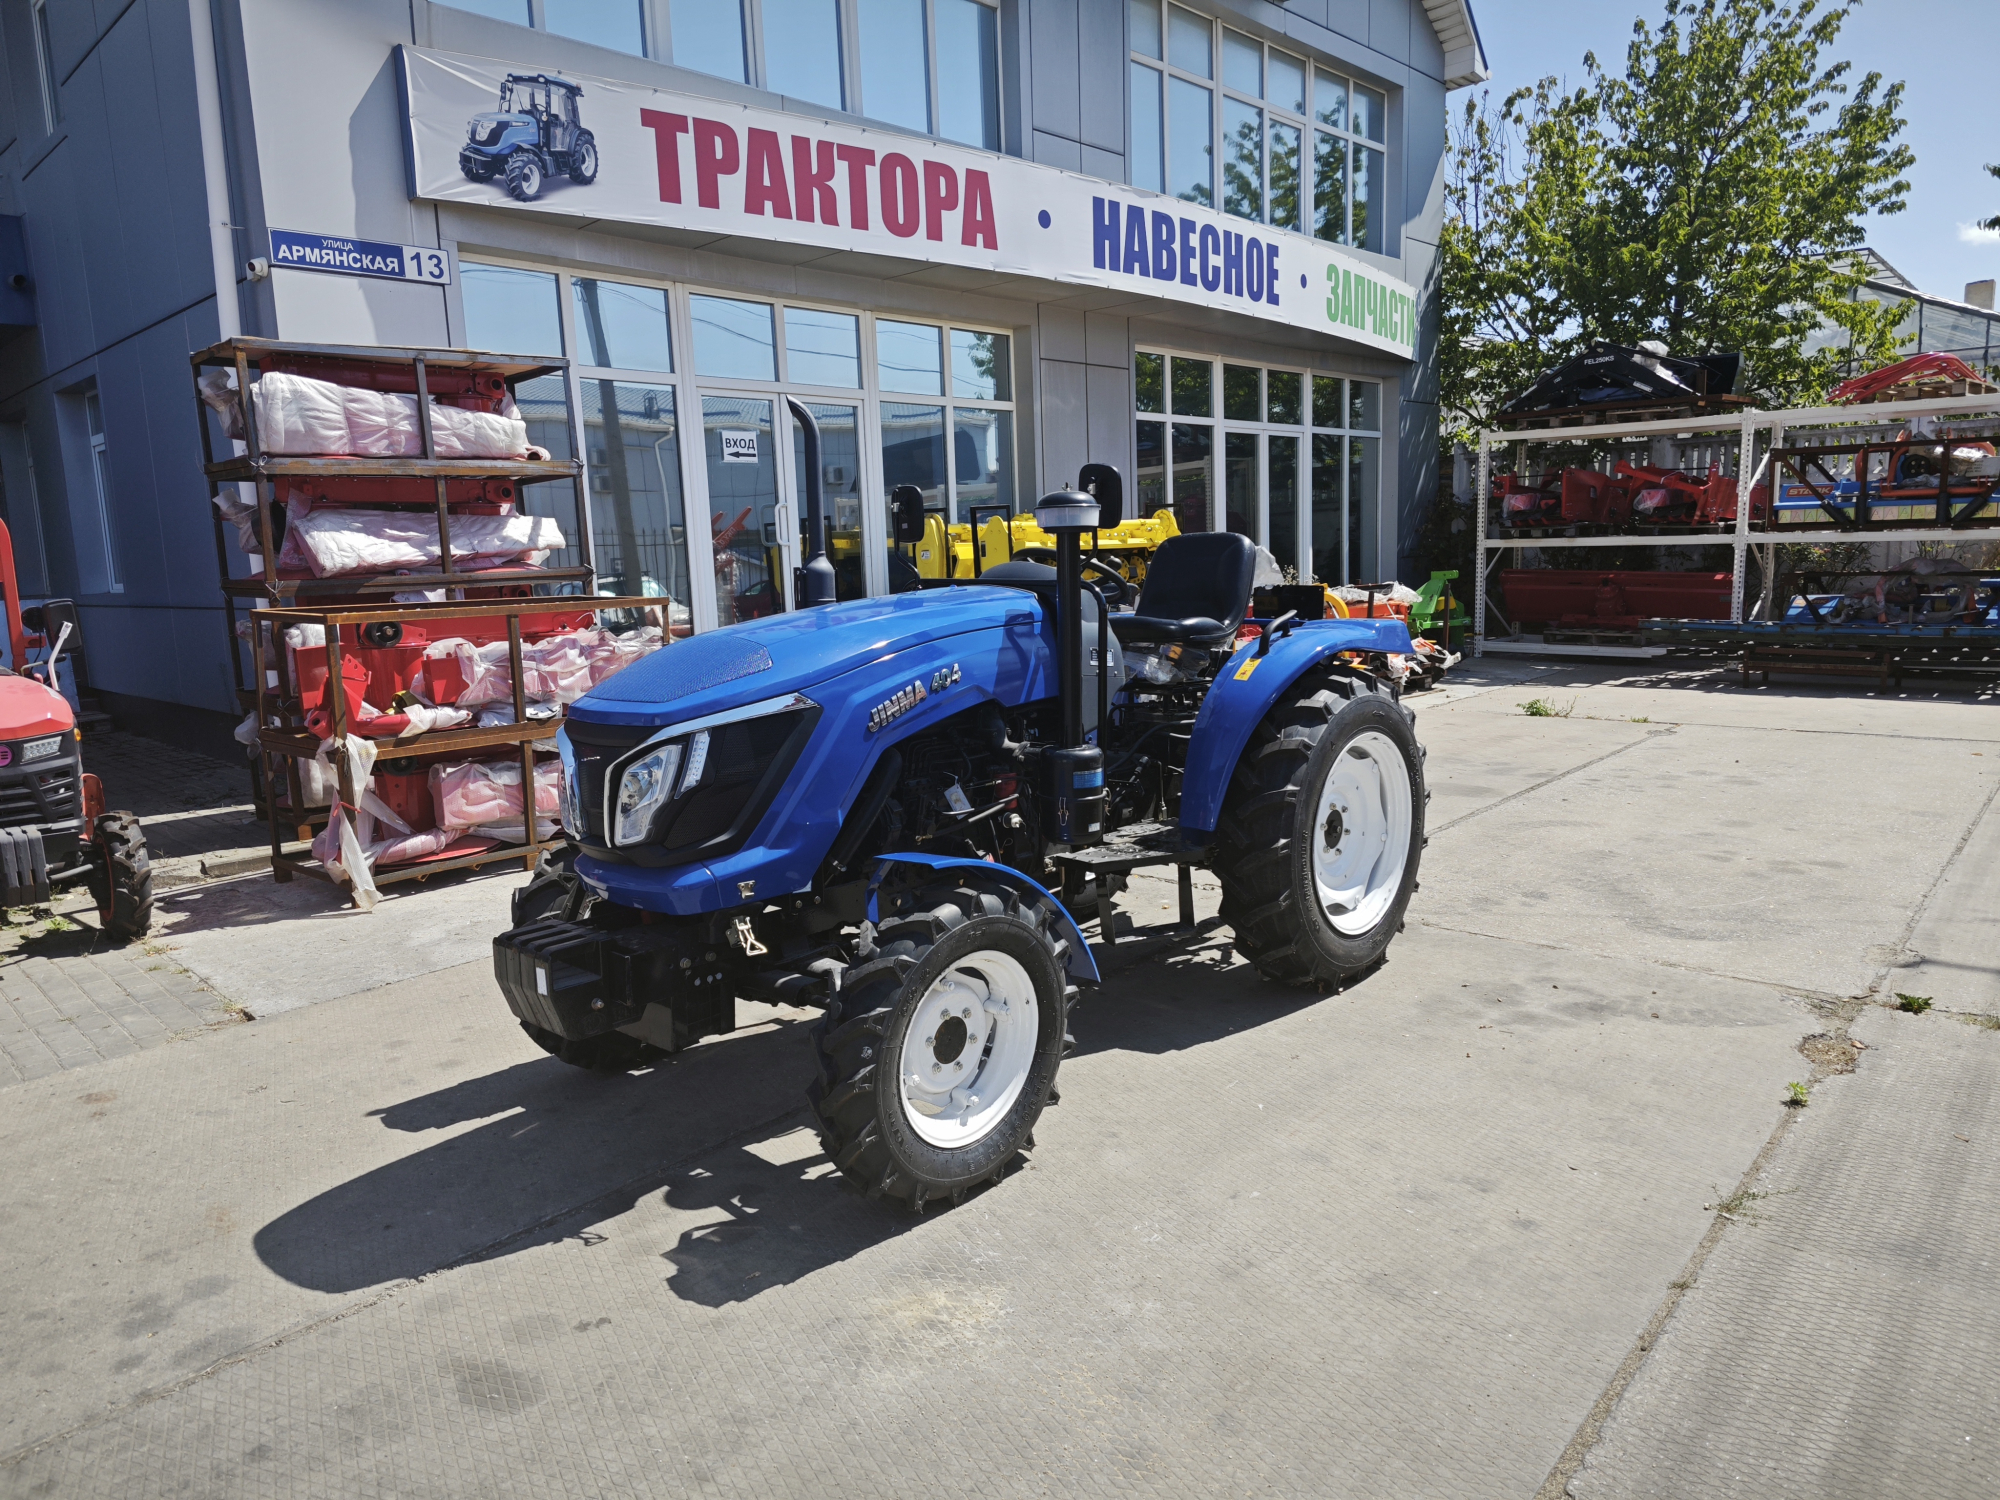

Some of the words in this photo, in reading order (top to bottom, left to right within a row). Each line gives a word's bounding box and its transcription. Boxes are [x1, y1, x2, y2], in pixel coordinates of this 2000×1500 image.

[322, 239, 354, 251] УЛИЦА
[640, 108, 998, 250] ТРАКТОРА
[1093, 196, 1280, 306] НАВЕСНОЕ
[1326, 263, 1414, 348] ЗАПЧАСТИ
[278, 244, 399, 273] АРМЯНСКАЯ
[410, 252, 444, 279] 13
[725, 437, 756, 451] ВХОД
[868, 680, 928, 733] JINMA
[931, 663, 962, 692] 404
